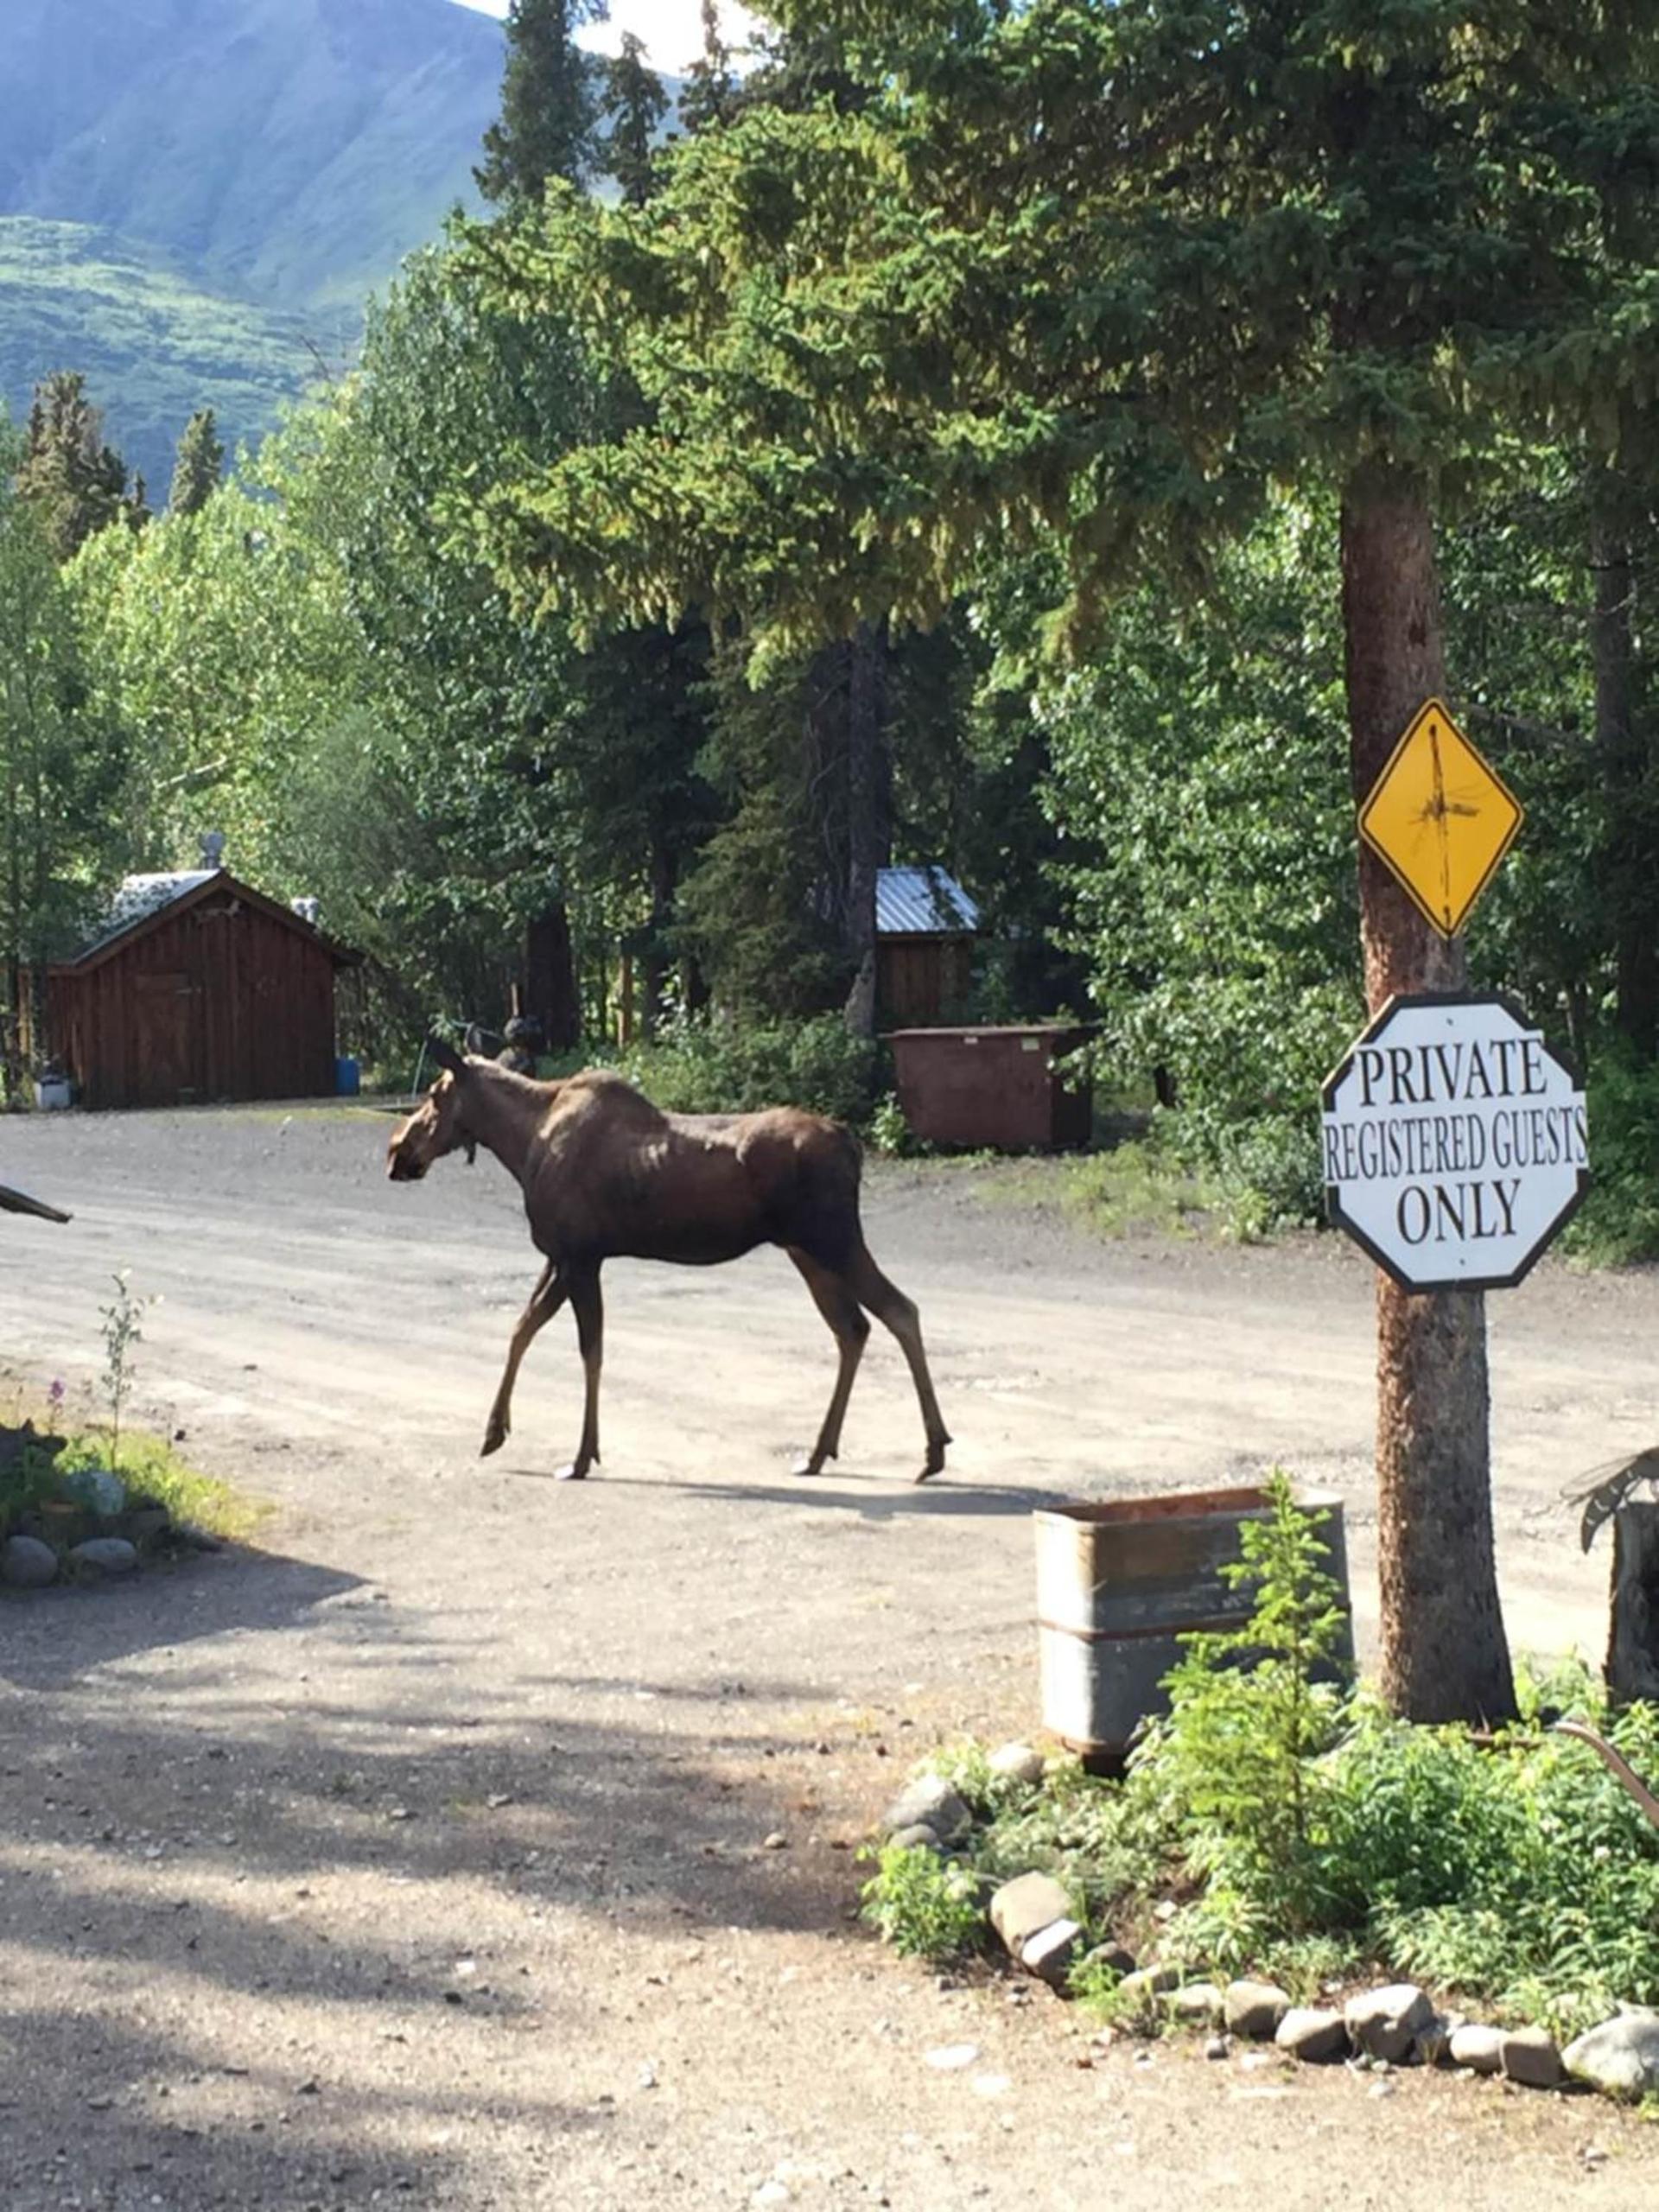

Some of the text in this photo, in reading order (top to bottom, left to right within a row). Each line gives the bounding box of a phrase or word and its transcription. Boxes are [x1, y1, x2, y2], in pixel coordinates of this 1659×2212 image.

[1358, 1038, 1547, 1107] PRIVATE
[1325, 1105, 1589, 1181] REGISTERED GUESTS
[1397, 1179, 1521, 1244] ONLY
